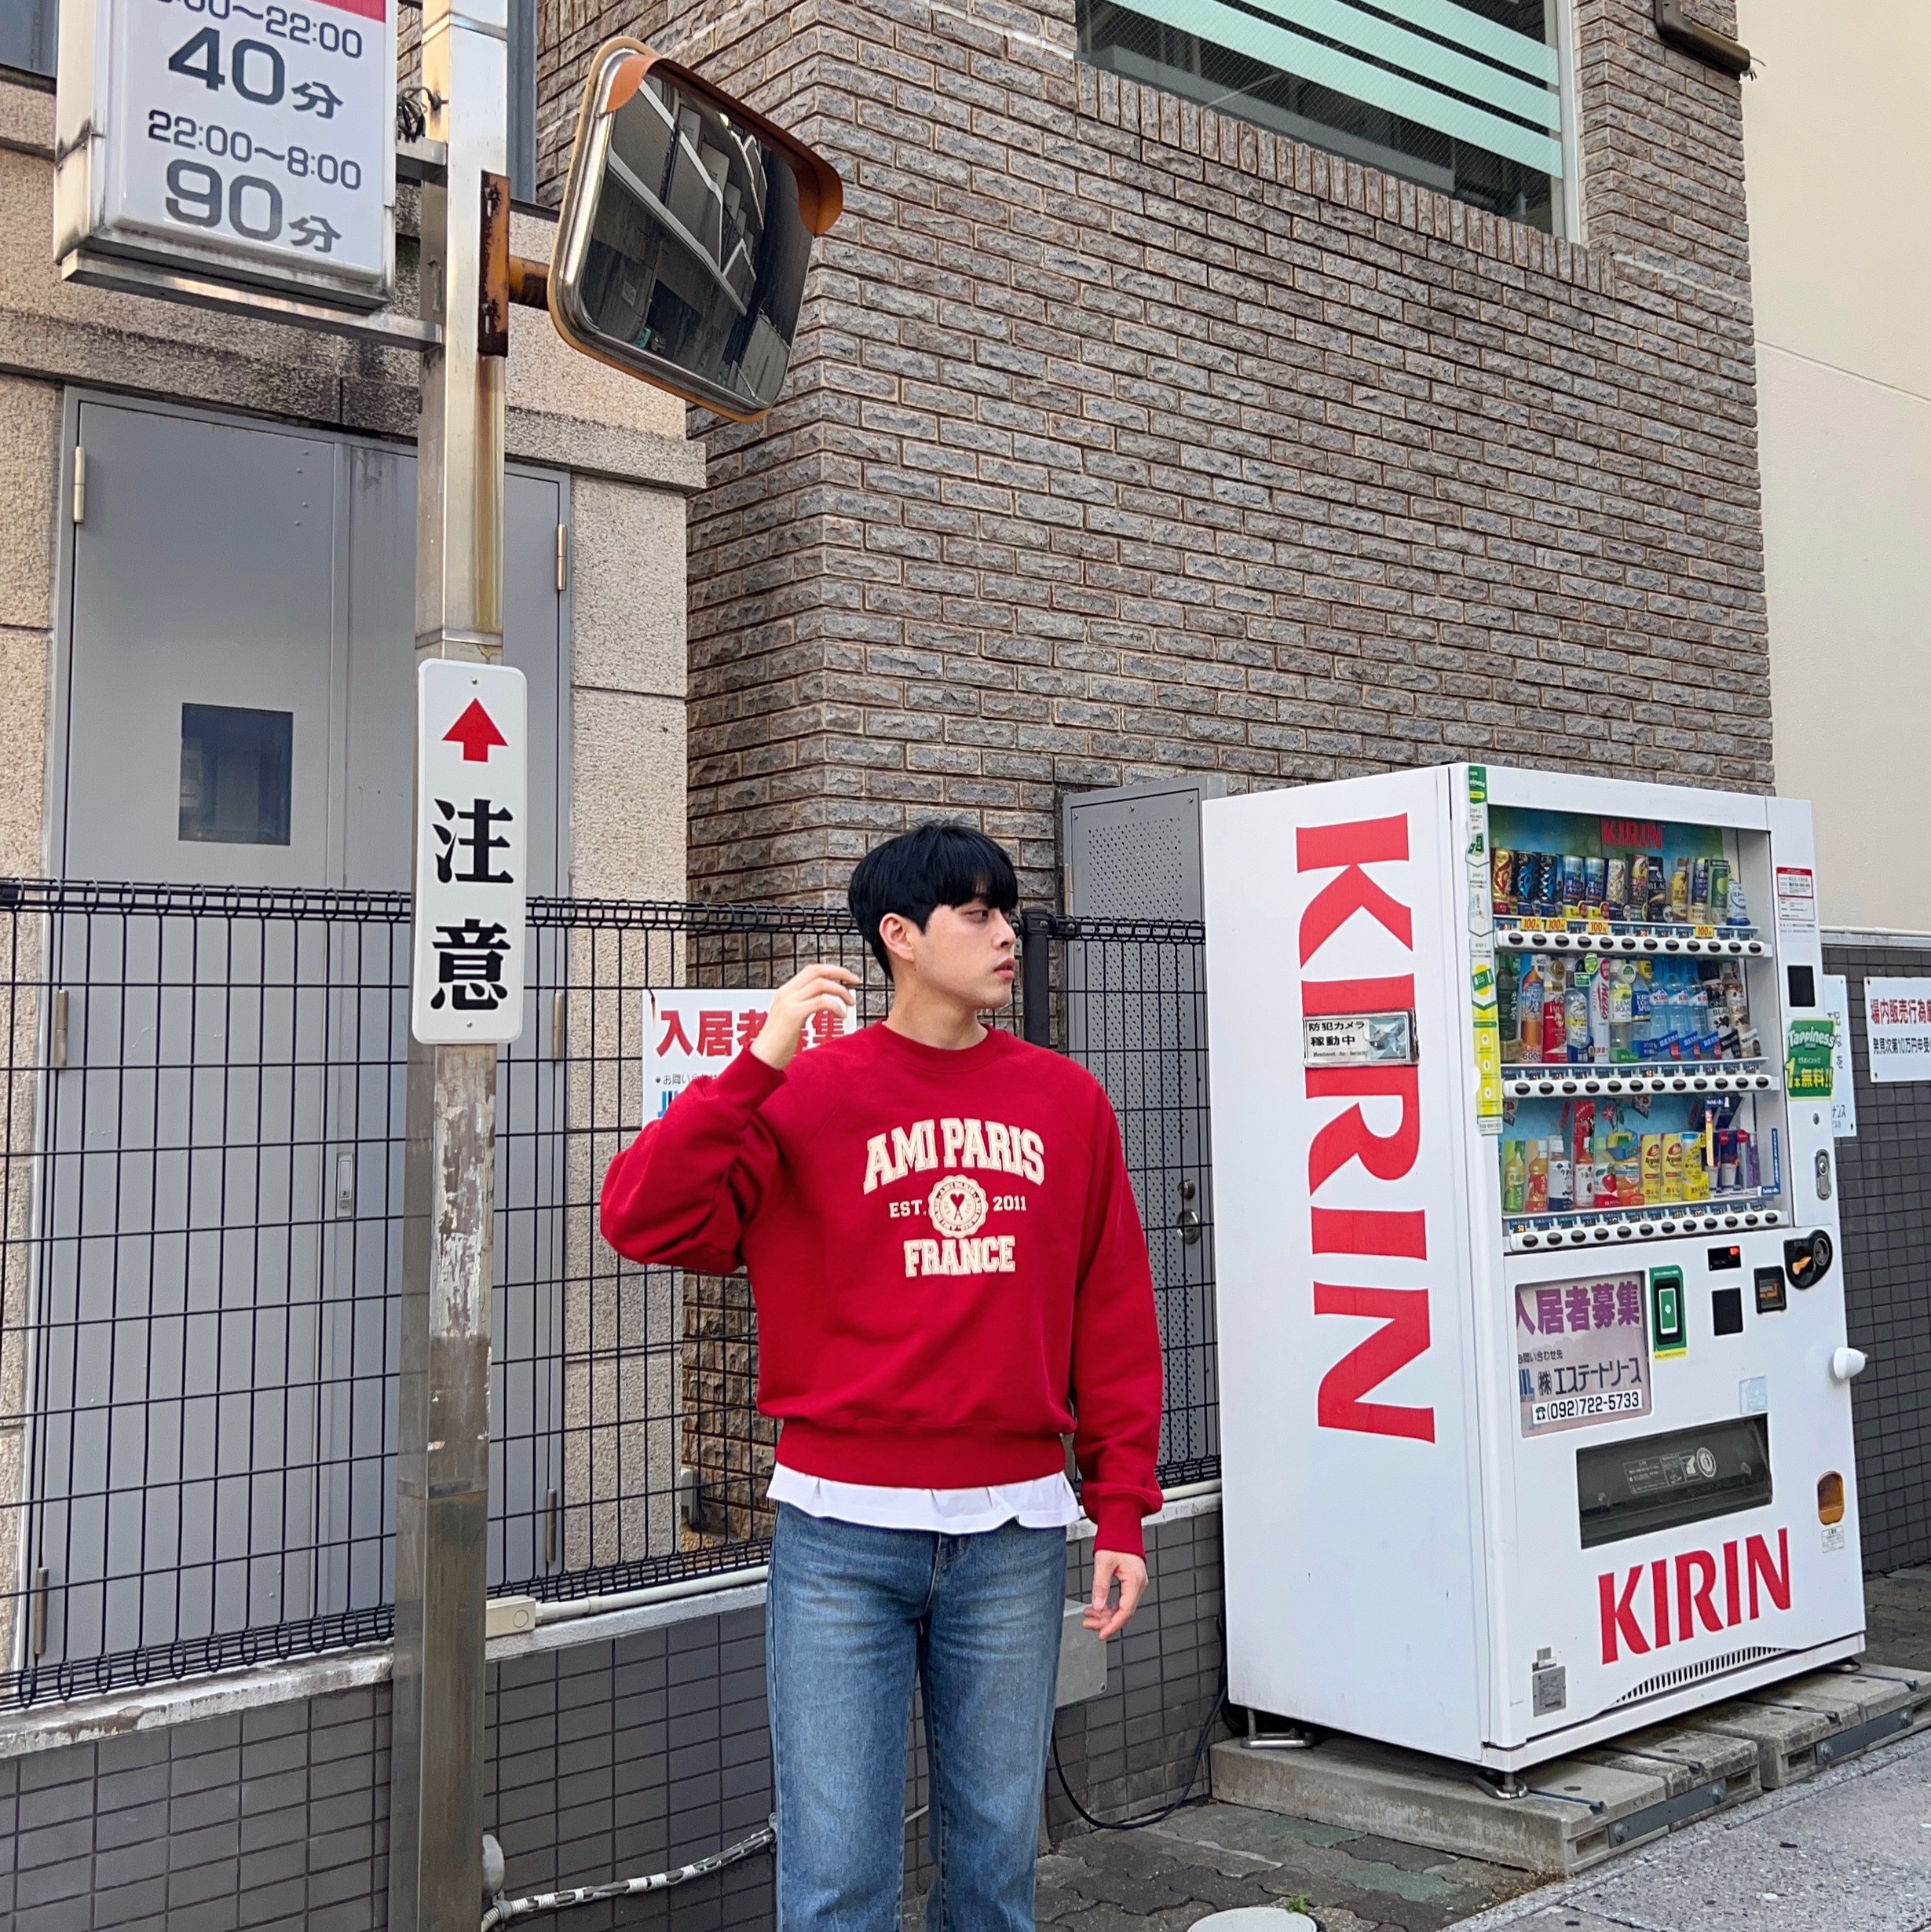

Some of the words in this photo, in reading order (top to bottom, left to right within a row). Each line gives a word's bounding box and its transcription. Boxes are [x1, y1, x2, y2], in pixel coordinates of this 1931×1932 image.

[168, 27, 343, 119] 40分
[166, 159, 342, 253] 90分
[1601, 819, 1663, 849] KIRIN
[430, 798, 514, 1011] 注意
[655, 1009, 845, 1057] 入居者集
[1308, 1021, 1365, 1032] 防犯カメラ
[1311, 1034, 1355, 1047] 稼動中
[1788, 1026, 1835, 1049] Tappiness
[1873, 1037, 1931, 1055] 発見次第10万円申受
[1296, 811, 1436, 1445] KIRIN
[863, 1118, 938, 1195] AMI
[939, 1117, 1045, 1187] PARIS
[889, 1198, 927, 1218] EST.
[992, 1195, 1027, 1212] 2011
[903, 1235, 1015, 1278] FRANCE
[1516, 1281, 1640, 1335] 入居者募集
[1546, 1391, 1640, 1421] (092)722-5733
[1596, 1528, 1792, 1665] KIRIN
